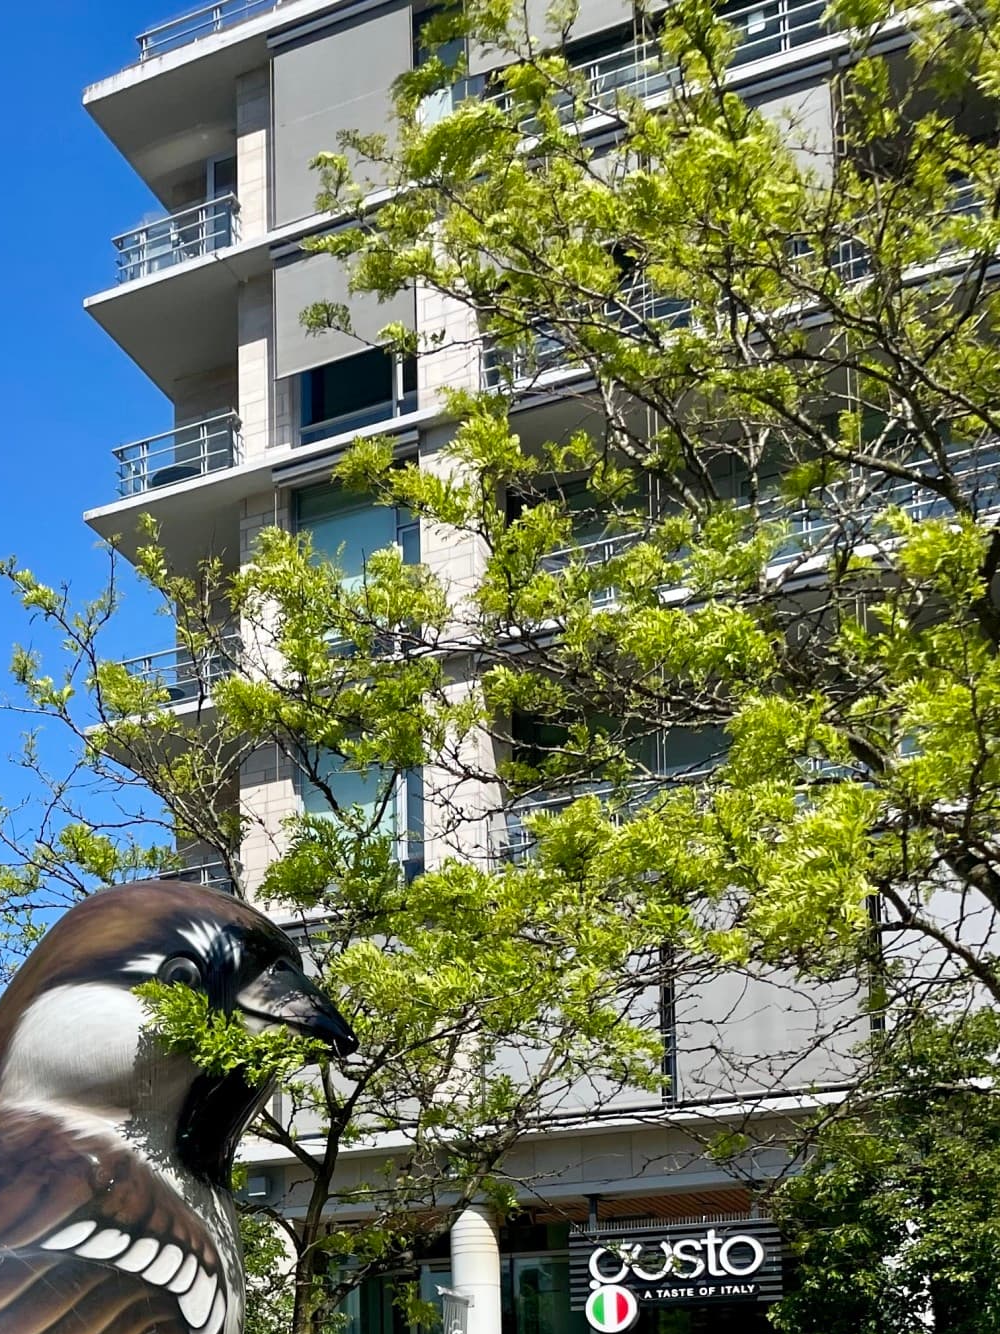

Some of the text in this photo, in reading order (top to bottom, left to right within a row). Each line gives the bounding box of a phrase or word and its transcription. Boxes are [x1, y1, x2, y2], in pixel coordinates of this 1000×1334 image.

[587, 1228, 765, 1292] gusto
[644, 1284, 755, 1299] A TASTE OF ITALY
